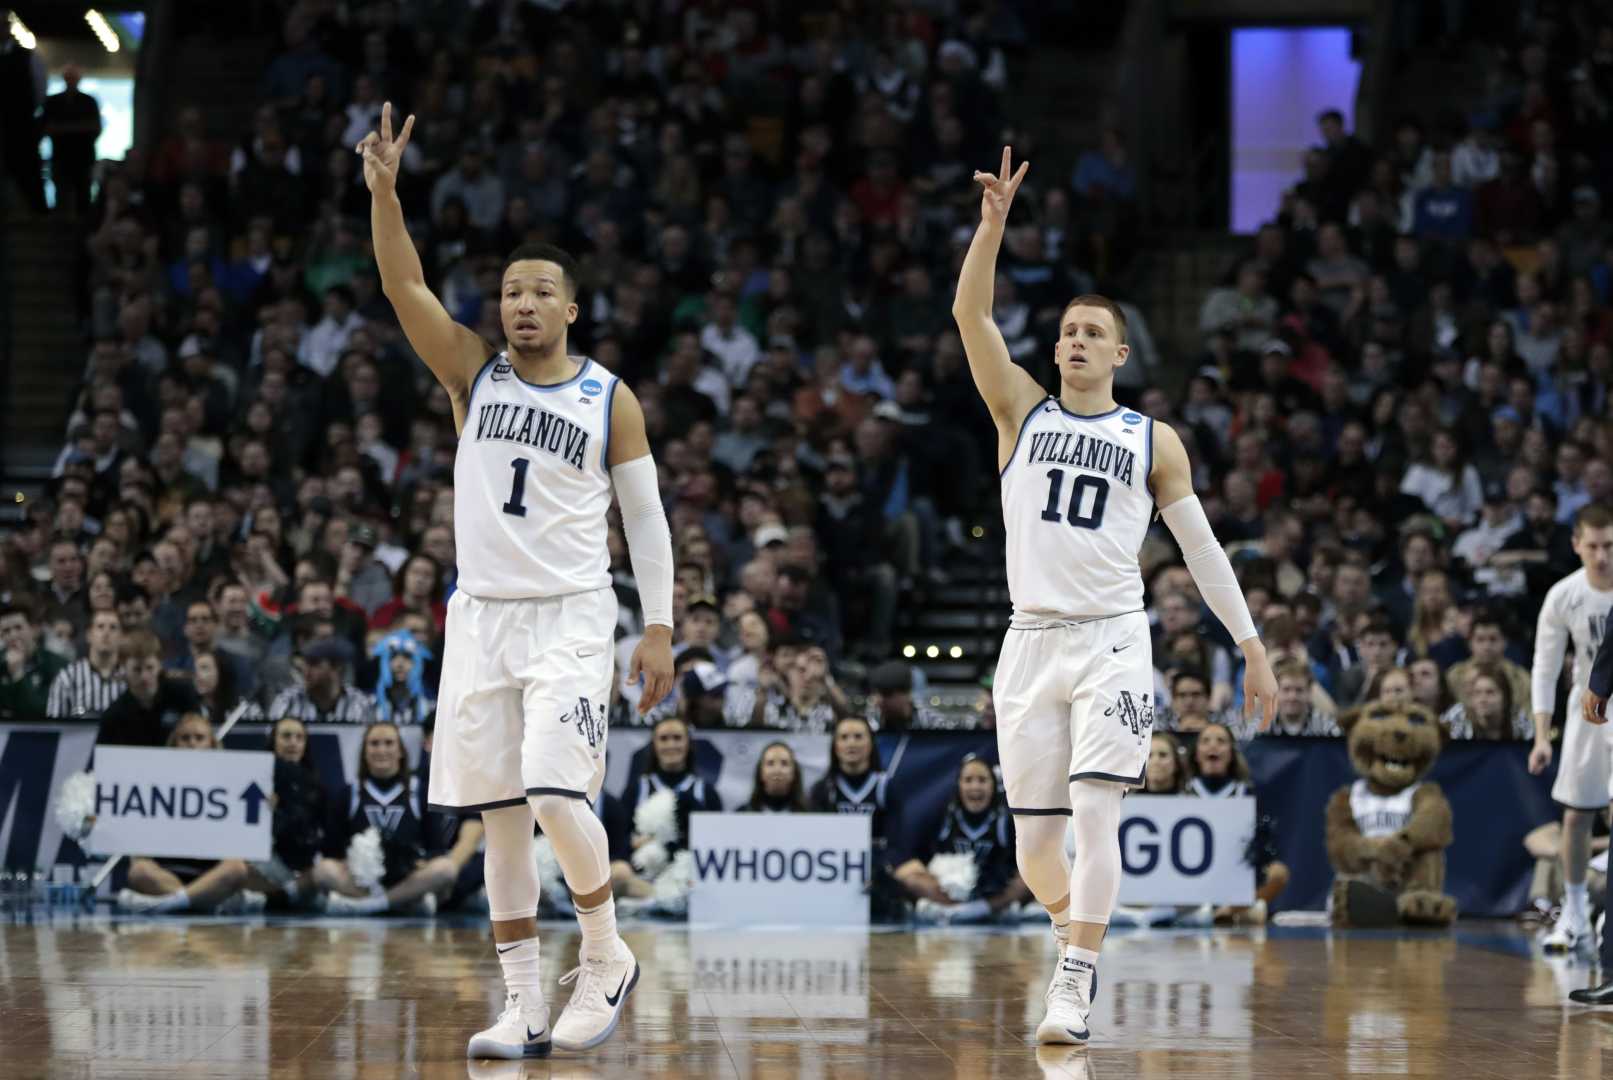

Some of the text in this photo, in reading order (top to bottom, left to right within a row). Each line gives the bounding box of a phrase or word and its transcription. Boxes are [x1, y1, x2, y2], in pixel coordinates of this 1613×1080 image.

[475, 402, 591, 474] VILLANOVA
[1027, 429, 1136, 489] VILLANOVA
[503, 457, 530, 518] 1
[1041, 468, 1110, 530] 10
[95, 783, 229, 820] HANDS
[693, 848, 867, 883] WHOOSH
[1118, 816, 1213, 876] GO
